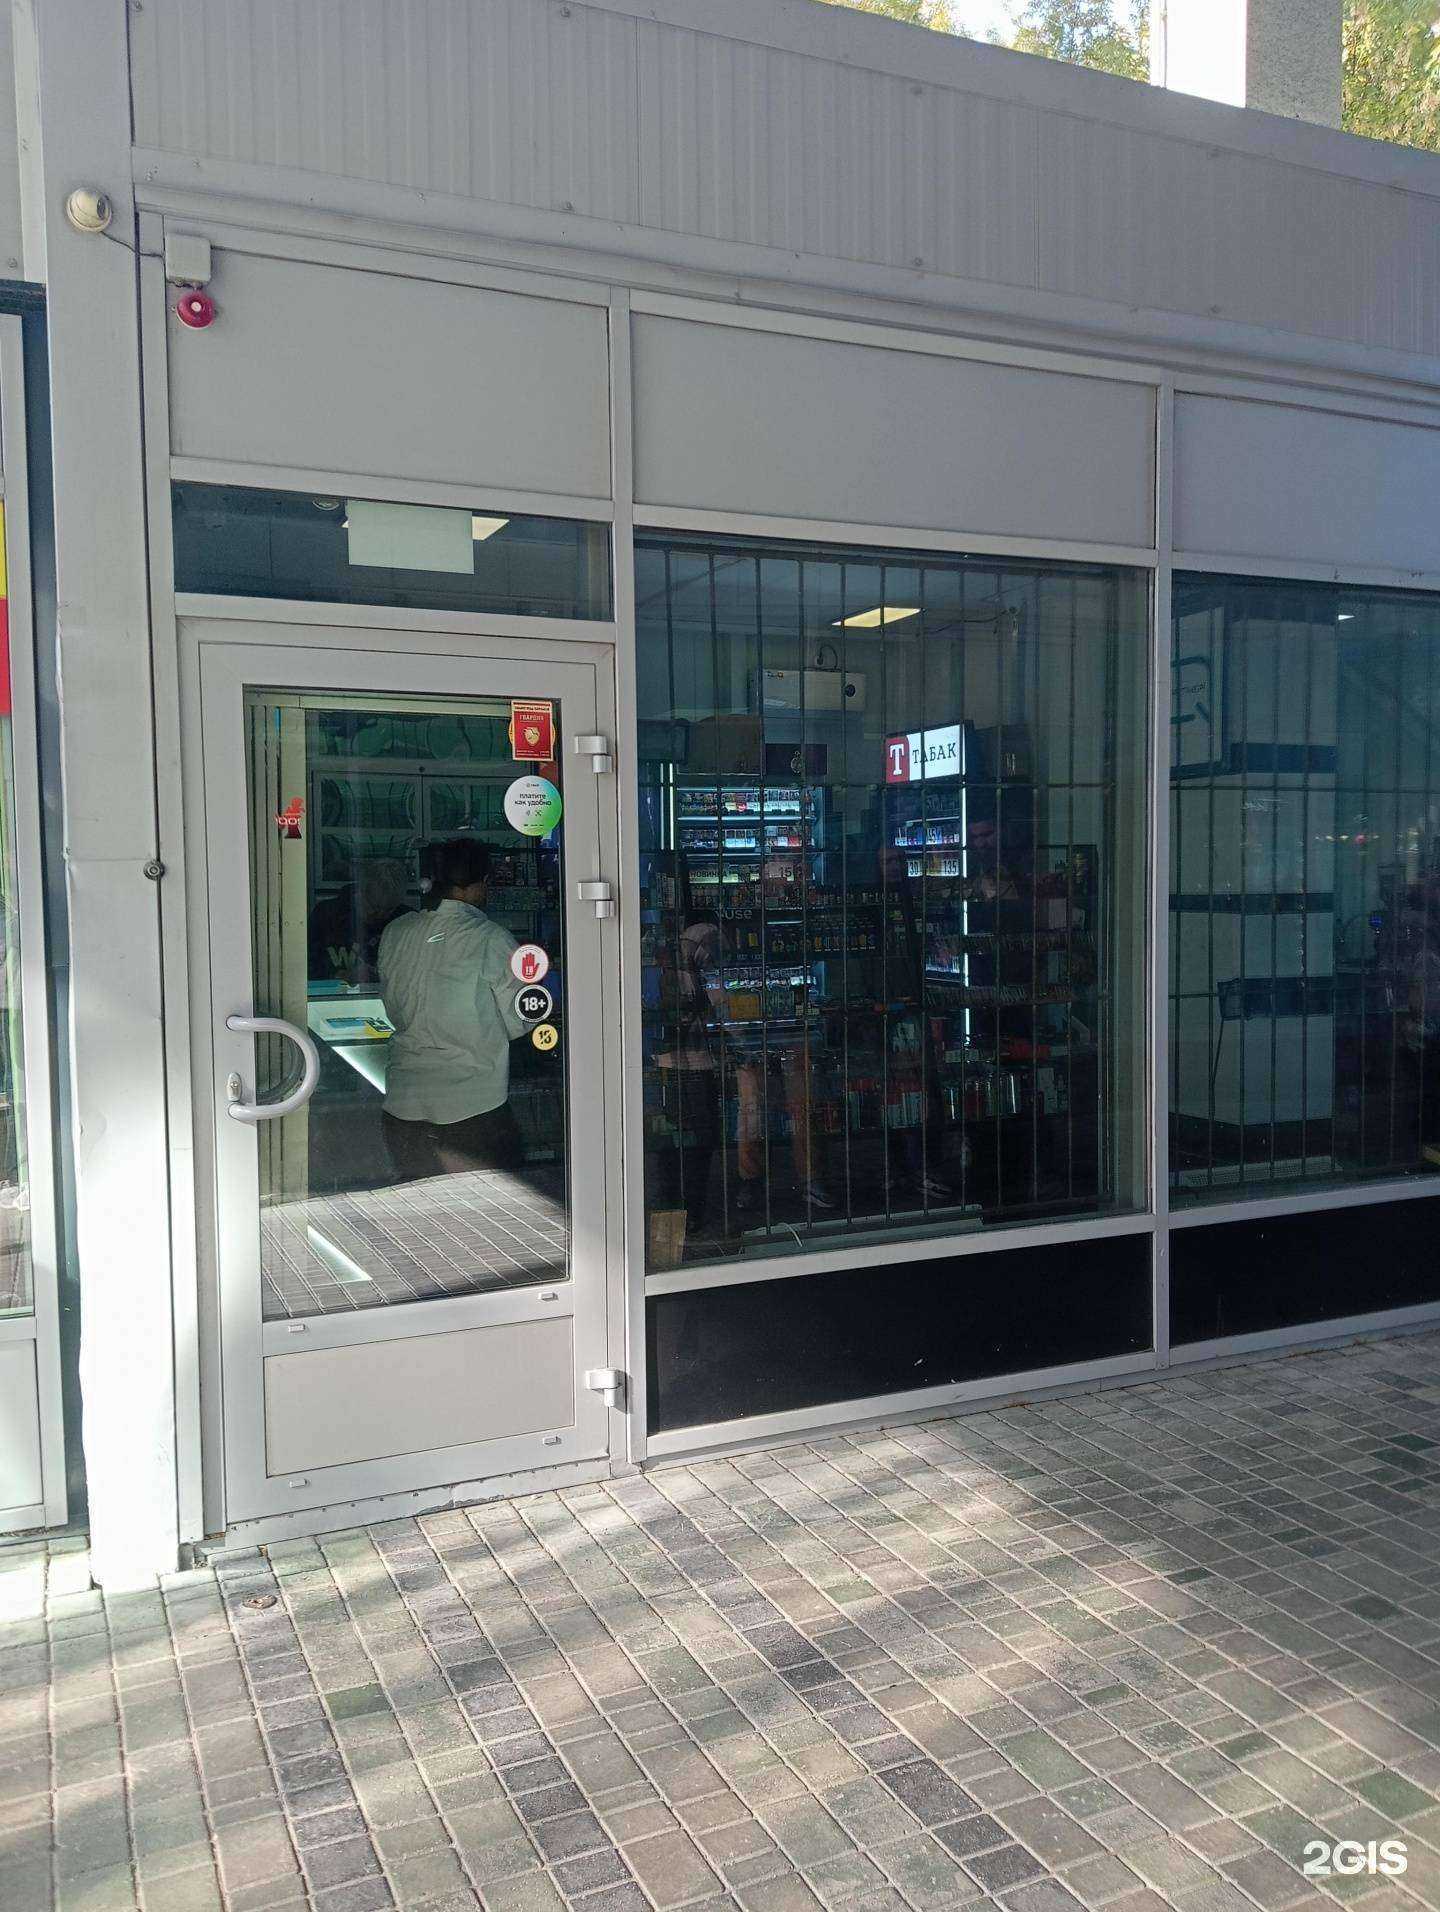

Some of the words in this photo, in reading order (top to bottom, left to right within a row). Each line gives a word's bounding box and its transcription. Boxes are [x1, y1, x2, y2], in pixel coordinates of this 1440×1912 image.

[912, 742, 957, 764] ТАБАК
[519, 792, 547, 800] платите
[528, 799, 552, 807] удобно
[522, 996, 546, 1011] 18+
